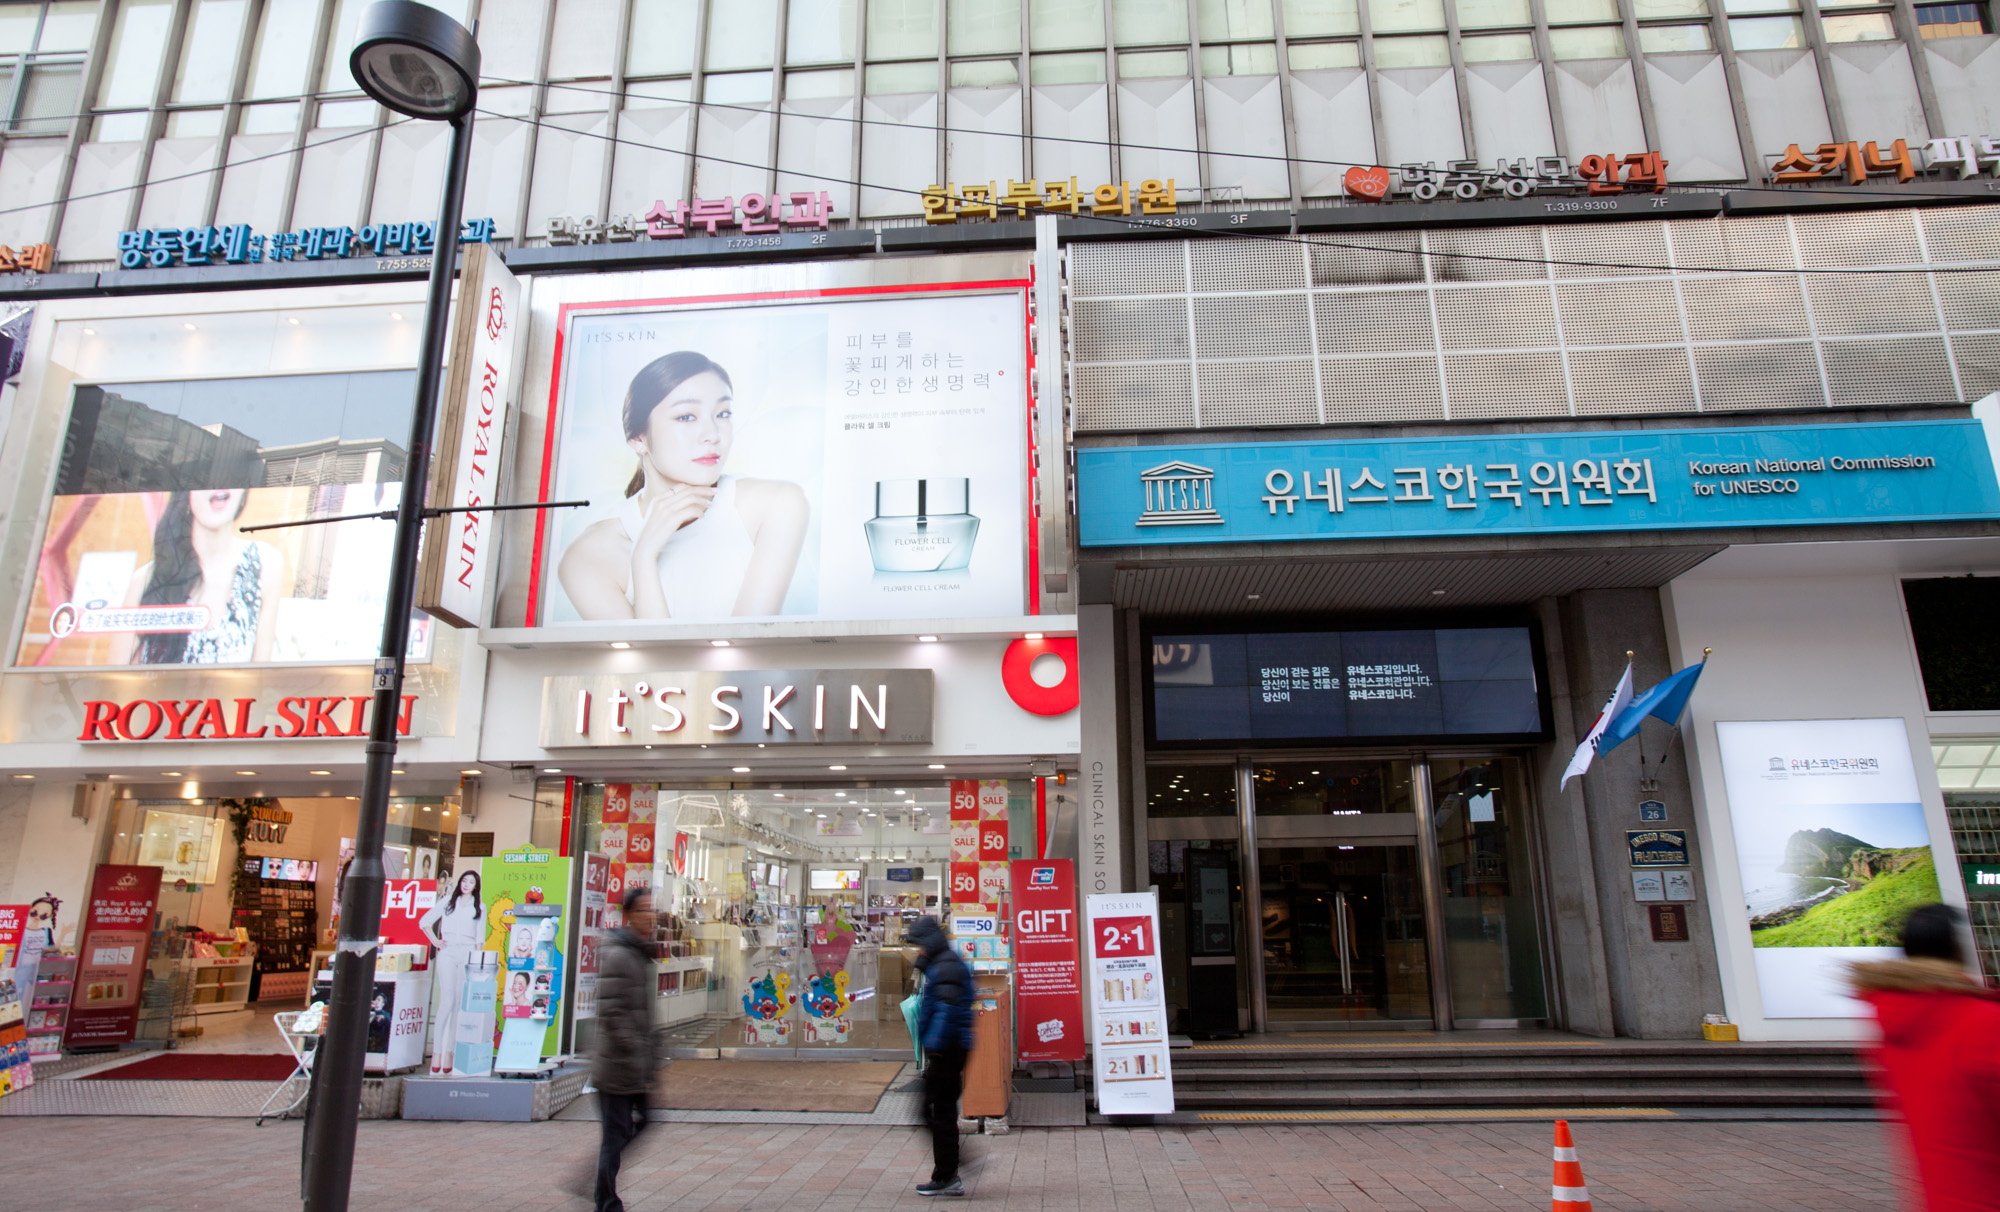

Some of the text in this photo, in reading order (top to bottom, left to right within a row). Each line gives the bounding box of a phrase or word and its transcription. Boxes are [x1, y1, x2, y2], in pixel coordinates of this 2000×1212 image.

[1771, 139, 1916, 186] 스키니
[921, 176, 1178, 225] 한피부과의원
[1650, 197, 1668, 209] 7F
[547, 191, 834, 247] 민유선 산부인과
[1230, 214, 1248, 225] 3F
[117, 223, 252, 269] 명동연세
[299, 226, 353, 261] 내과
[358, 217, 497, 256] 이비인과
[812, 234, 827, 246] 2F
[846, 331, 913, 350] 피부를
[844, 421, 891, 430] 플라워 셀 크림
[1689, 453, 1936, 475] Korean National Commission
[457, 361, 498, 592] ROYAL SKIN
[1261, 457, 1658, 515] 유네스코한국위원회
[1693, 478, 1800, 496] for UNESCO
[1145, 478, 1213, 512] UNESCO
[894, 538, 928, 546] FLOWER
[934, 583, 960, 591] CREAM
[1260, 667, 1289, 678] 당신이
[1311, 666, 1331, 677] 길은
[379, 674, 387, 686] 8
[1261, 679, 1290, 691] 당신이
[1291, 679, 1310, 690] 보는
[1312, 678, 1341, 690] 건물은
[1262, 691, 1290, 703] 당신이
[708, 683, 889, 732] SKIN
[77, 697, 269, 741] ROYAL
[1791, 757, 1879, 770] 유네스코한국위원회
[606, 797, 627, 813] 50
[633, 799, 654, 809] SALE
[954, 794, 975, 810] 50
[983, 796, 1004, 805] SALE
[1648, 810, 1659, 819] 26
[1091, 760, 1106, 895] CLINICAL SKIN SO
[604, 839, 624, 848] SALE
[630, 837, 651, 852] 50
[954, 837, 975, 847] SALE
[983, 835, 1004, 850] 50
[1630, 832, 1684, 848] UNESCO HOUSE
[504, 853, 549, 863] SESAME STREET
[522, 873, 547, 881] SKIN
[589, 863, 606, 888] 2+1
[628, 879, 648, 889] SALE
[954, 876, 975, 892] 50
[983, 878, 1005, 888] SALE
[1118, 901, 1142, 910] SKIN
[603, 921, 619, 929] ALE
[976, 919, 992, 932] 50
[1017, 909, 1072, 933] GIFT
[1103, 925, 1145, 951] 2+1
[399, 1006, 423, 1020] OPEN
[395, 1020, 423, 1036] EVENT
